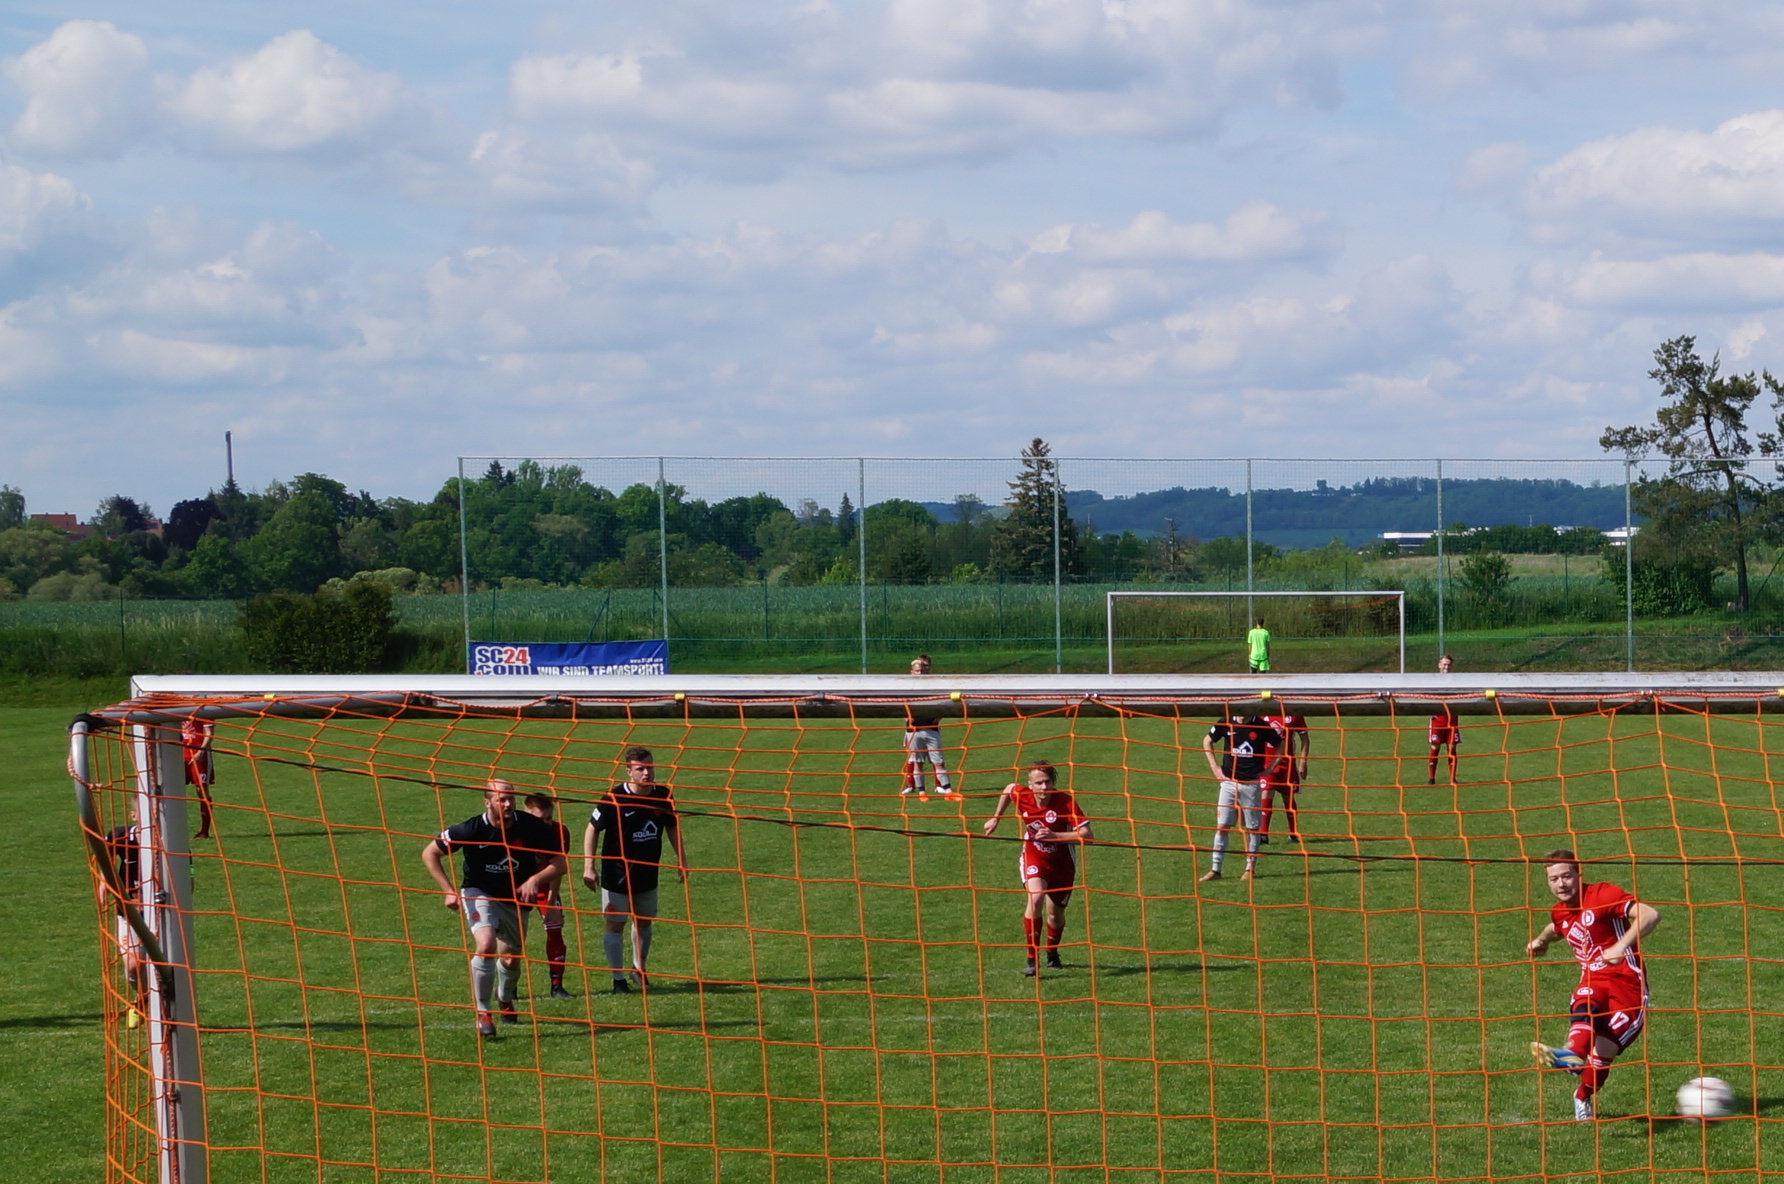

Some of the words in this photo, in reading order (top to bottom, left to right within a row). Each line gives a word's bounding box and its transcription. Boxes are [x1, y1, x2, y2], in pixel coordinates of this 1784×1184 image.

[475, 646, 530, 664] SC24
[537, 666, 561, 676] WIR
[562, 666, 589, 676] SIND
[591, 663, 665, 676] TEAMSPORT!
